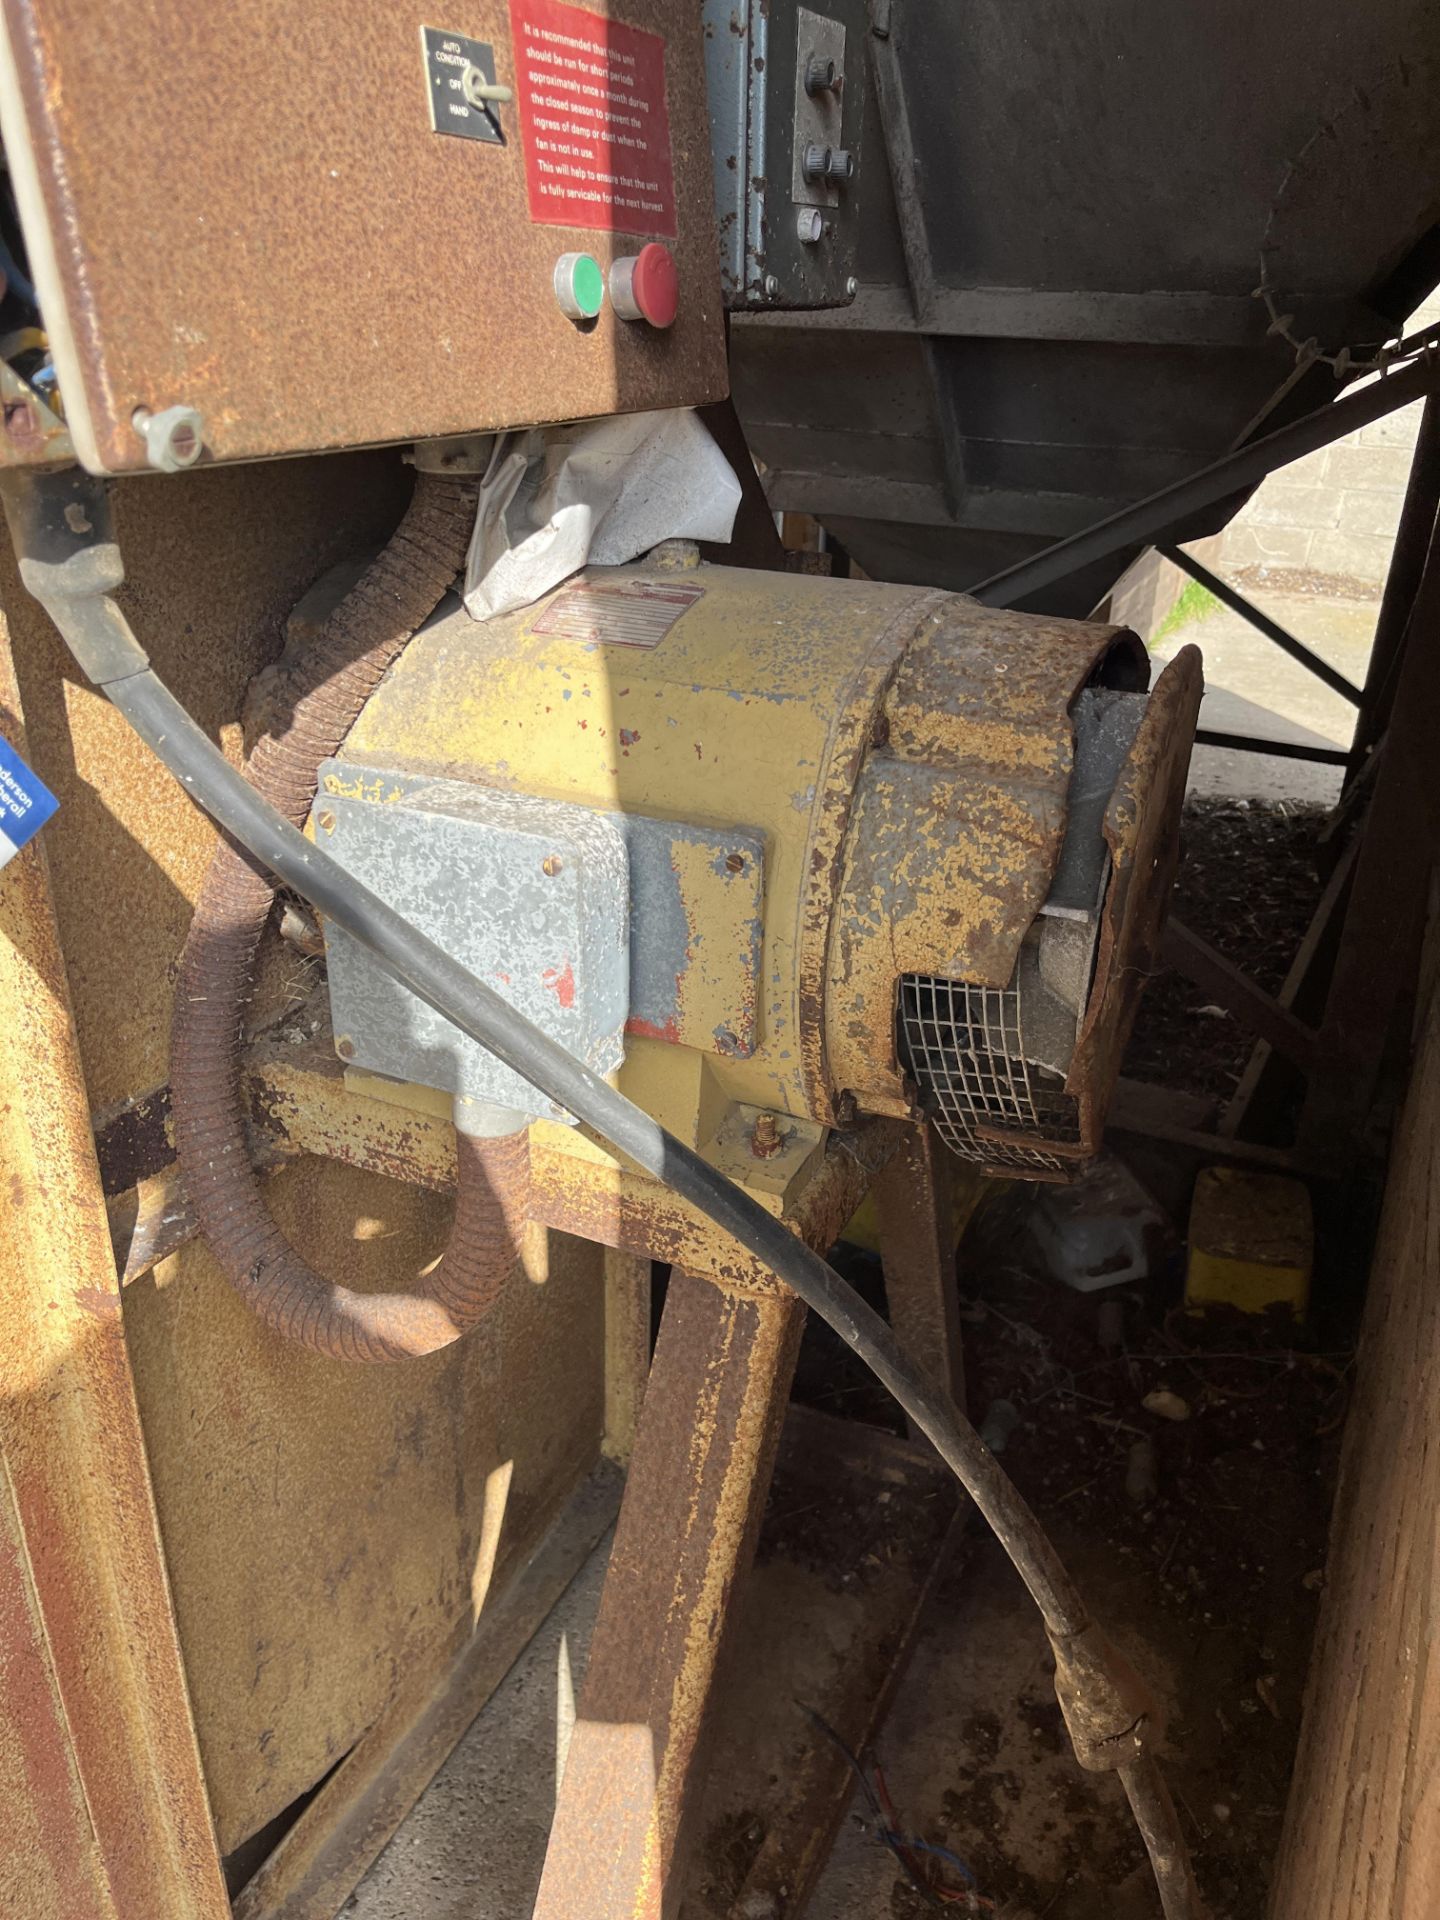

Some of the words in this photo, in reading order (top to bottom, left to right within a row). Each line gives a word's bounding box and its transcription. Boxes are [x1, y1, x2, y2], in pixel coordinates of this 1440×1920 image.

[443, 40, 461, 54] AUTO
[524, 22, 531, 34] It
[533, 26, 539, 37] is
[542, 28, 591, 51] recommended
[593, 42, 607, 57] that
[608, 49, 621, 62] this
[623, 54, 635, 66] unit
[526, 47, 551, 62] should
[554, 54, 562, 65] be
[564, 58, 576, 68] run
[579, 59, 588, 72] for
[591, 64, 608, 78] short
[610, 72, 634, 86] periods
[450, 79, 462, 90] OFF
[529, 71, 580, 94] approximately
[583, 85, 598, 96] once
[601, 89, 604, 98] a
[606, 92, 627, 104] month
[629, 96, 648, 112] during
[450, 104, 468, 117] HAND
[531, 93, 544, 105] the
[546, 96, 568, 110] closed
[571, 103, 594, 116] season
[596, 110, 603, 119] to
[605, 113, 629, 126] prevent
[631, 118, 641, 128] the
[534, 115, 560, 131] ingress
[562, 122, 569, 132] of
[572, 124, 590, 139] damp
[592, 128, 599, 138] or
[601, 130, 616, 143] dust
[618, 136, 634, 147] when
[636, 139, 647, 149] the
[536, 138, 548, 150] fan
[550, 141, 556, 152] is
[558, 144, 570, 154] not
[572, 146, 578, 156] in
[580, 150, 594, 159] use.
[538, 159, 553, 172] This
[556, 164, 569, 175] will
[571, 168, 586, 180] help
[588, 172, 594, 180] to
[597, 173, 618, 183] ensure
[620, 176, 633, 187] that
[635, 179, 645, 189] the
[646, 183, 658, 191] unit
[540, 183, 547, 194] is
[548, 184, 564, 198] fully
[567, 188, 601, 202] servicable
[602, 192, 612, 203] for
[614, 195, 624, 206] the
[626, 199, 640, 209] next
